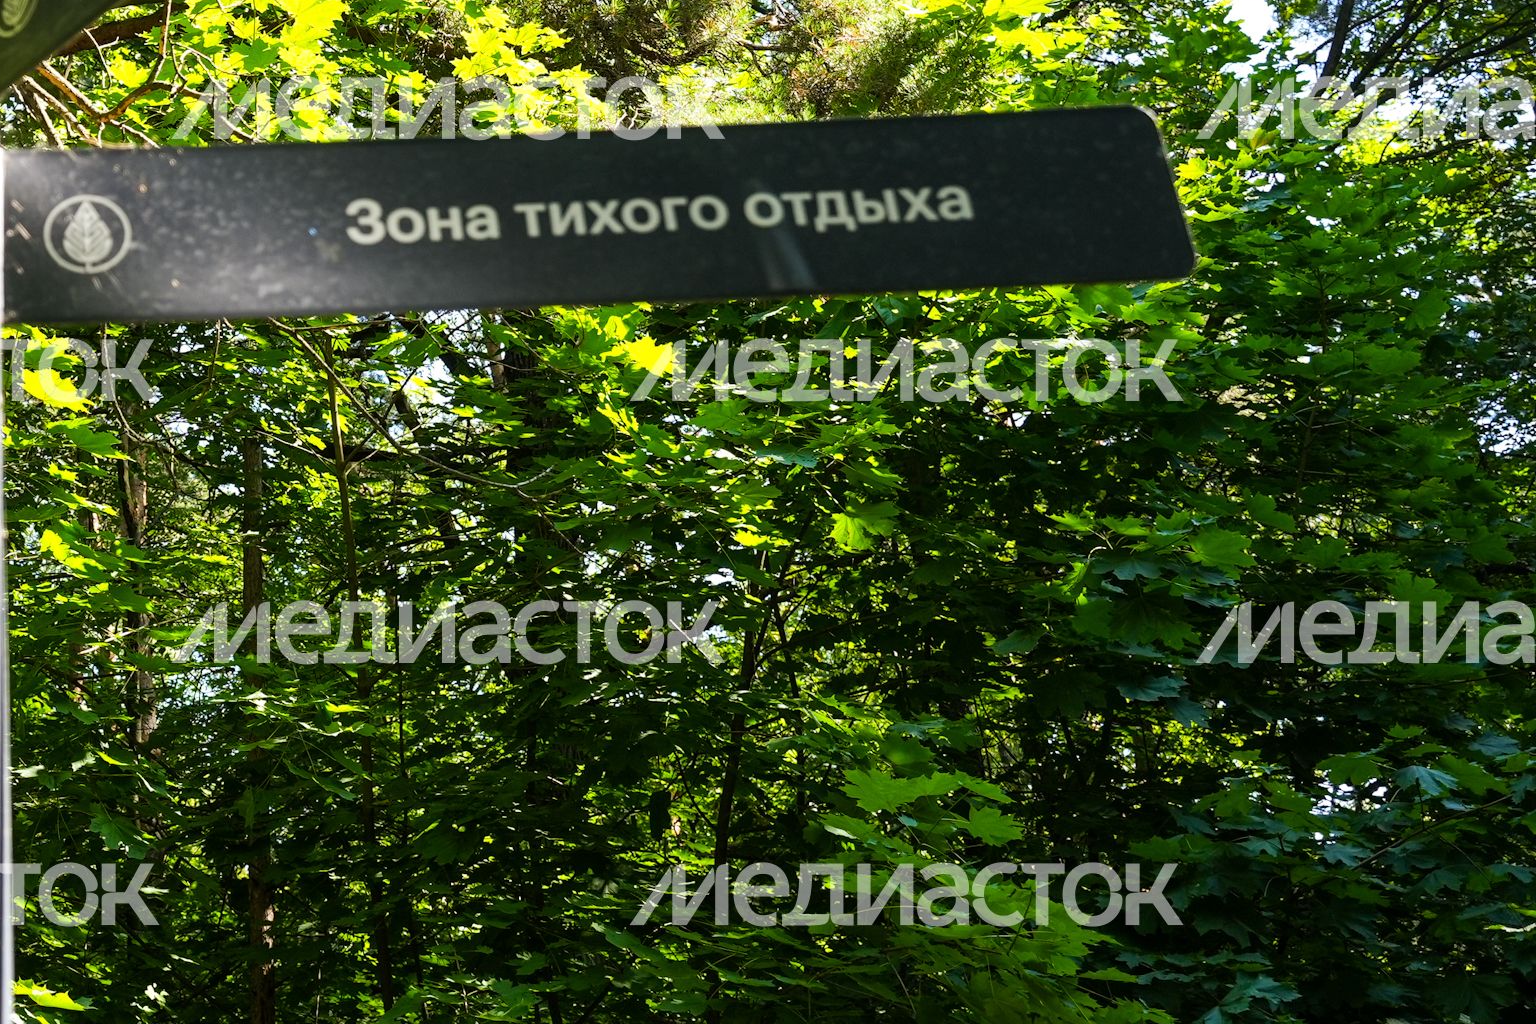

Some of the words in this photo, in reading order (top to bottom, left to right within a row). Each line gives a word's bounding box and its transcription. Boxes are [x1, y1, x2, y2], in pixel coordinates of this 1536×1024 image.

[345, 187, 501, 245] Зона
[514, 195, 729, 238] тихого
[744, 185, 974, 233] отдыха
